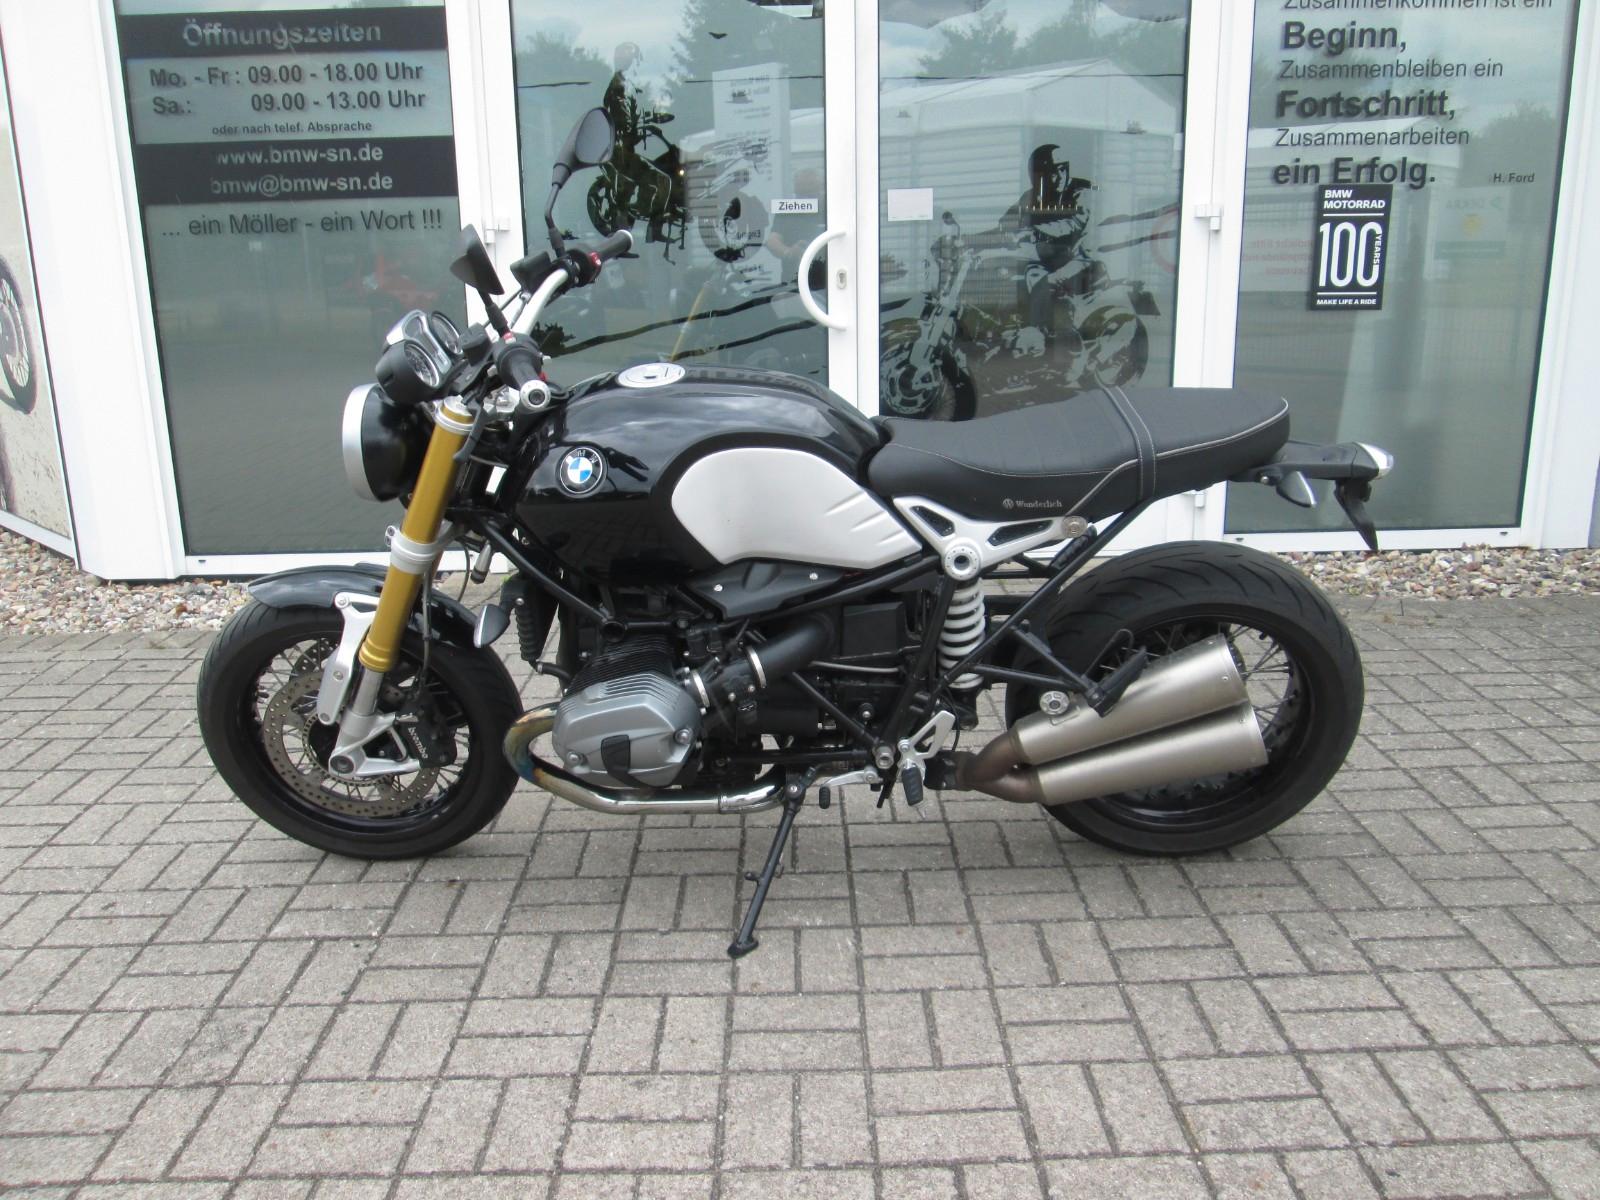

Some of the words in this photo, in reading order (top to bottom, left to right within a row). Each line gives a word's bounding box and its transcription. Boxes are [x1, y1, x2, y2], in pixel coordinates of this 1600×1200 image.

[182, 18, 381, 50] Öffnungszeiten
[1283, 20, 1407, 55] Beginn,
[150, 68, 187, 87] Mo.
[248, 65, 302, 84] 09.00
[324, 62, 378, 81] 18.00
[385, 62, 423, 80] Uhr
[1280, 59, 1467, 80] Zusammenbleiben
[1474, 58, 1504, 78] ein
[153, 96, 192, 115] Sa.:
[252, 92, 305, 112] 09.00
[327, 90, 381, 110] 13.00
[388, 89, 426, 108] Uhr
[1275, 89, 1455, 120] Fortschritt,
[212, 125, 239, 135] oder
[242, 123, 271, 134] nach
[274, 122, 304, 133] telef.
[307, 121, 372, 134] Absprache
[1276, 127, 1470, 147] Zusammenarbeiten
[217, 143, 384, 165] www.bmw-sn.de
[210, 172, 393, 197] bmw@bmw-sn.de
[1273, 158, 1320, 184] ein
[1333, 156, 1436, 189] Erfolg.
[1493, 172, 1505, 183] H.
[1508, 172, 1535, 183] Ford
[778, 201, 813, 211] Ziehen
[1323, 200, 1386, 209] MOTORRAD
[1324, 189, 1353, 199] BMW
[188, 214, 222, 236] ein
[229, 213, 298, 234] Möller
[320, 211, 353, 232] ein
[360, 209, 415, 230] Wort
[1319, 221, 1383, 287] 100
[1373, 234, 1383, 265] YEARS
